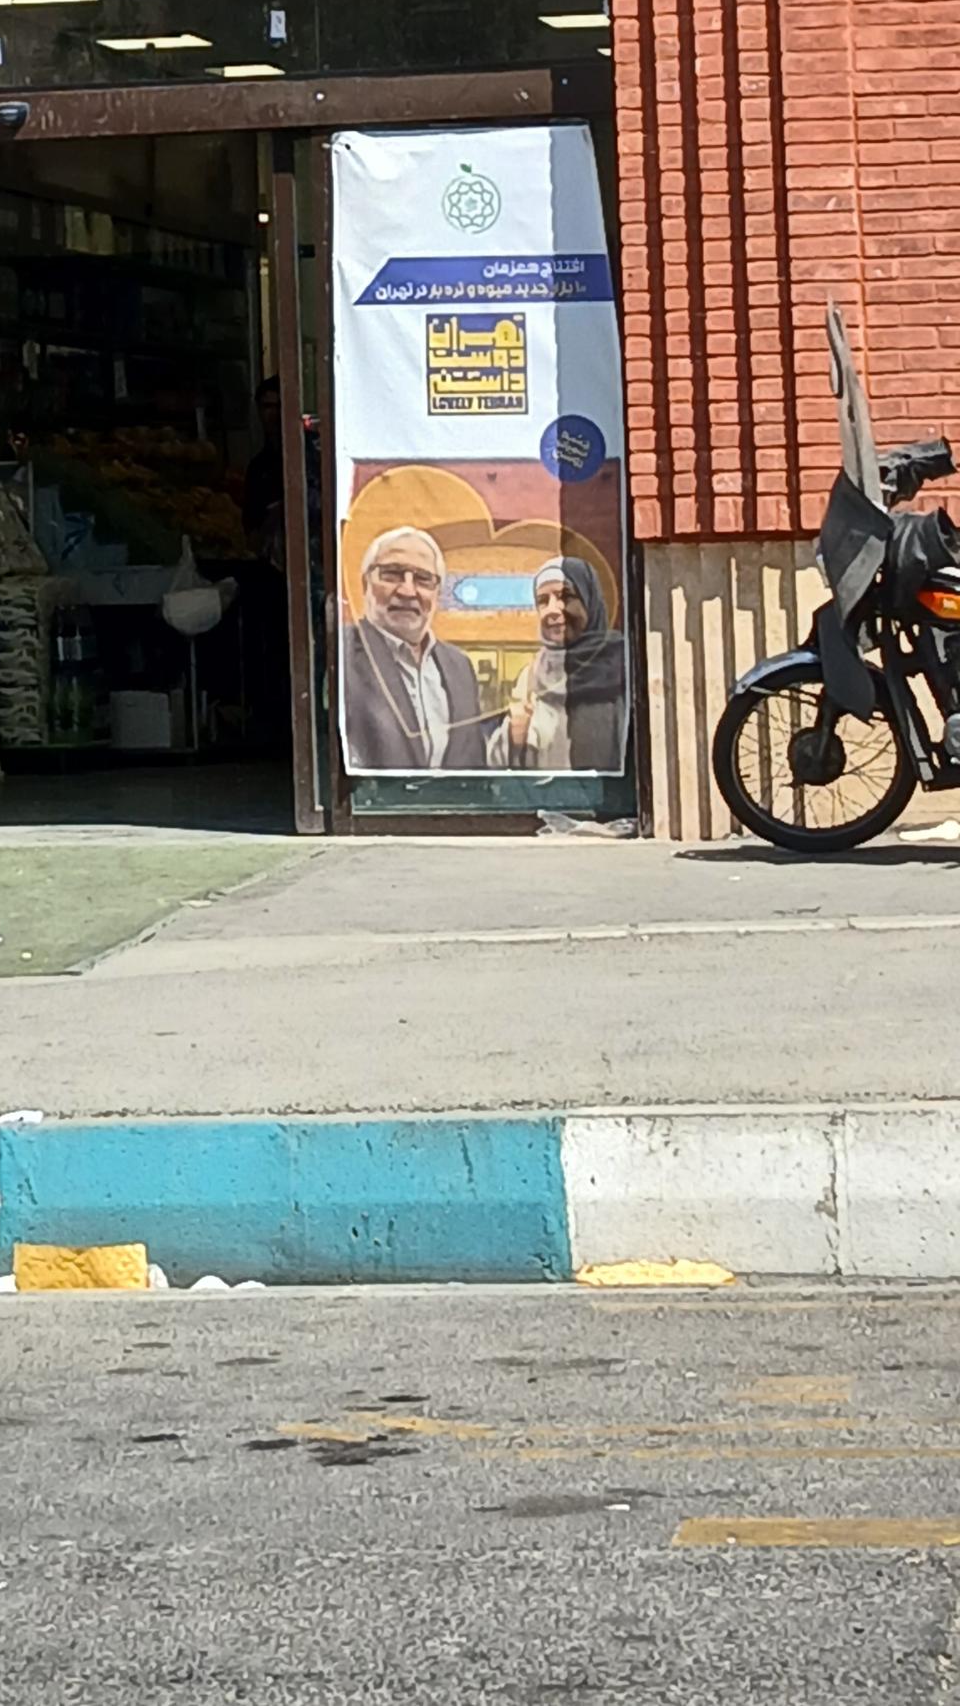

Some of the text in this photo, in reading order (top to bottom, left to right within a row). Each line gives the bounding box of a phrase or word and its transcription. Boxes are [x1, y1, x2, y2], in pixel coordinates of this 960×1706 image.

[375, 281, 414, 301] تهران
[414, 283, 428, 300] در
[467, 283, 476, 299] و
[477, 283, 513, 299] میوه
[514, 281, 549, 298] جدید
[428, 315, 524, 351] تهران
